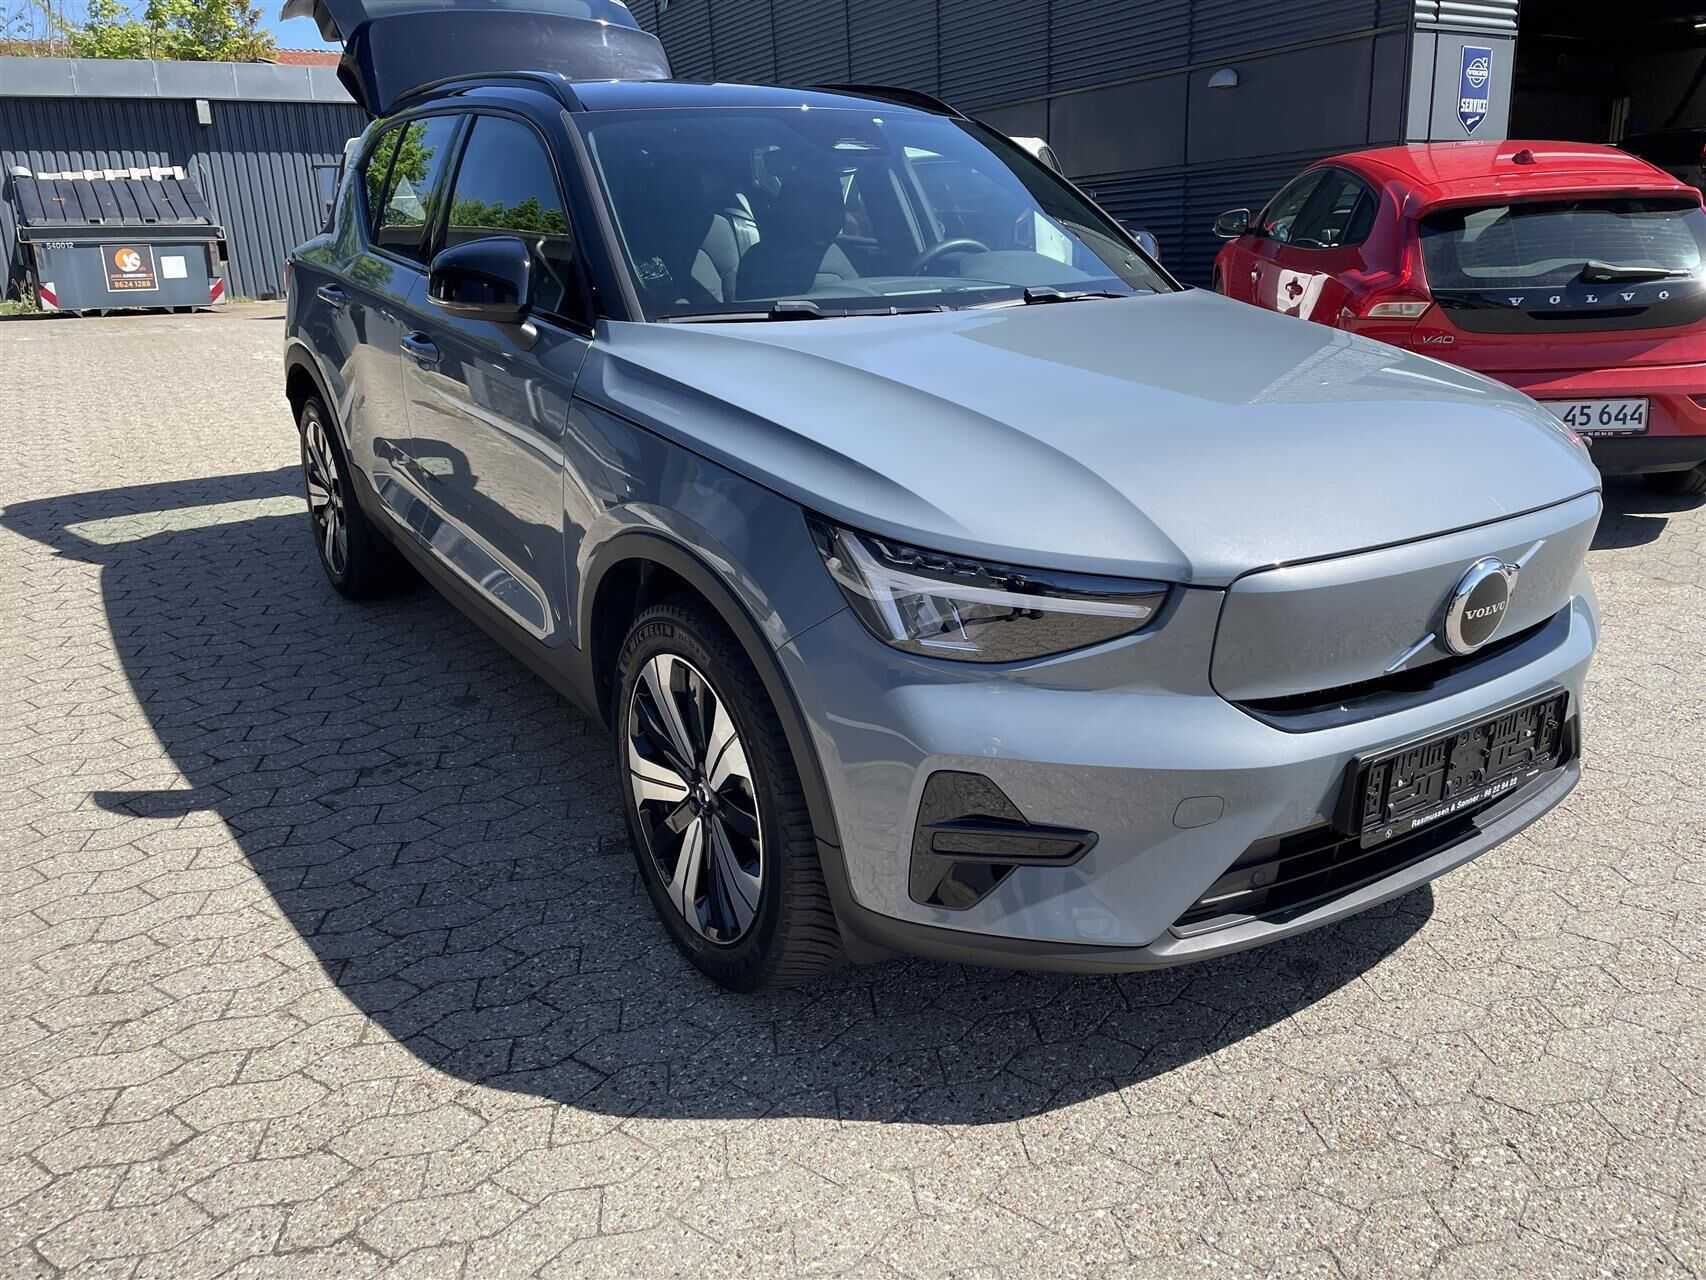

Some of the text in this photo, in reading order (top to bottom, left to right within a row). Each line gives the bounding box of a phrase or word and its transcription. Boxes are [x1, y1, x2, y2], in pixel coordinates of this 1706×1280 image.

[1460, 98, 1487, 113] SERVICE
[46, 242, 74, 250] 540012
[1508, 290, 1669, 306] VOLVO
[1422, 335, 1455, 344] V40
[1562, 403, 1643, 426] 45 644
[1465, 600, 1506, 620] VOLVO
[1411, 807, 1450, 828] Rasmussen
